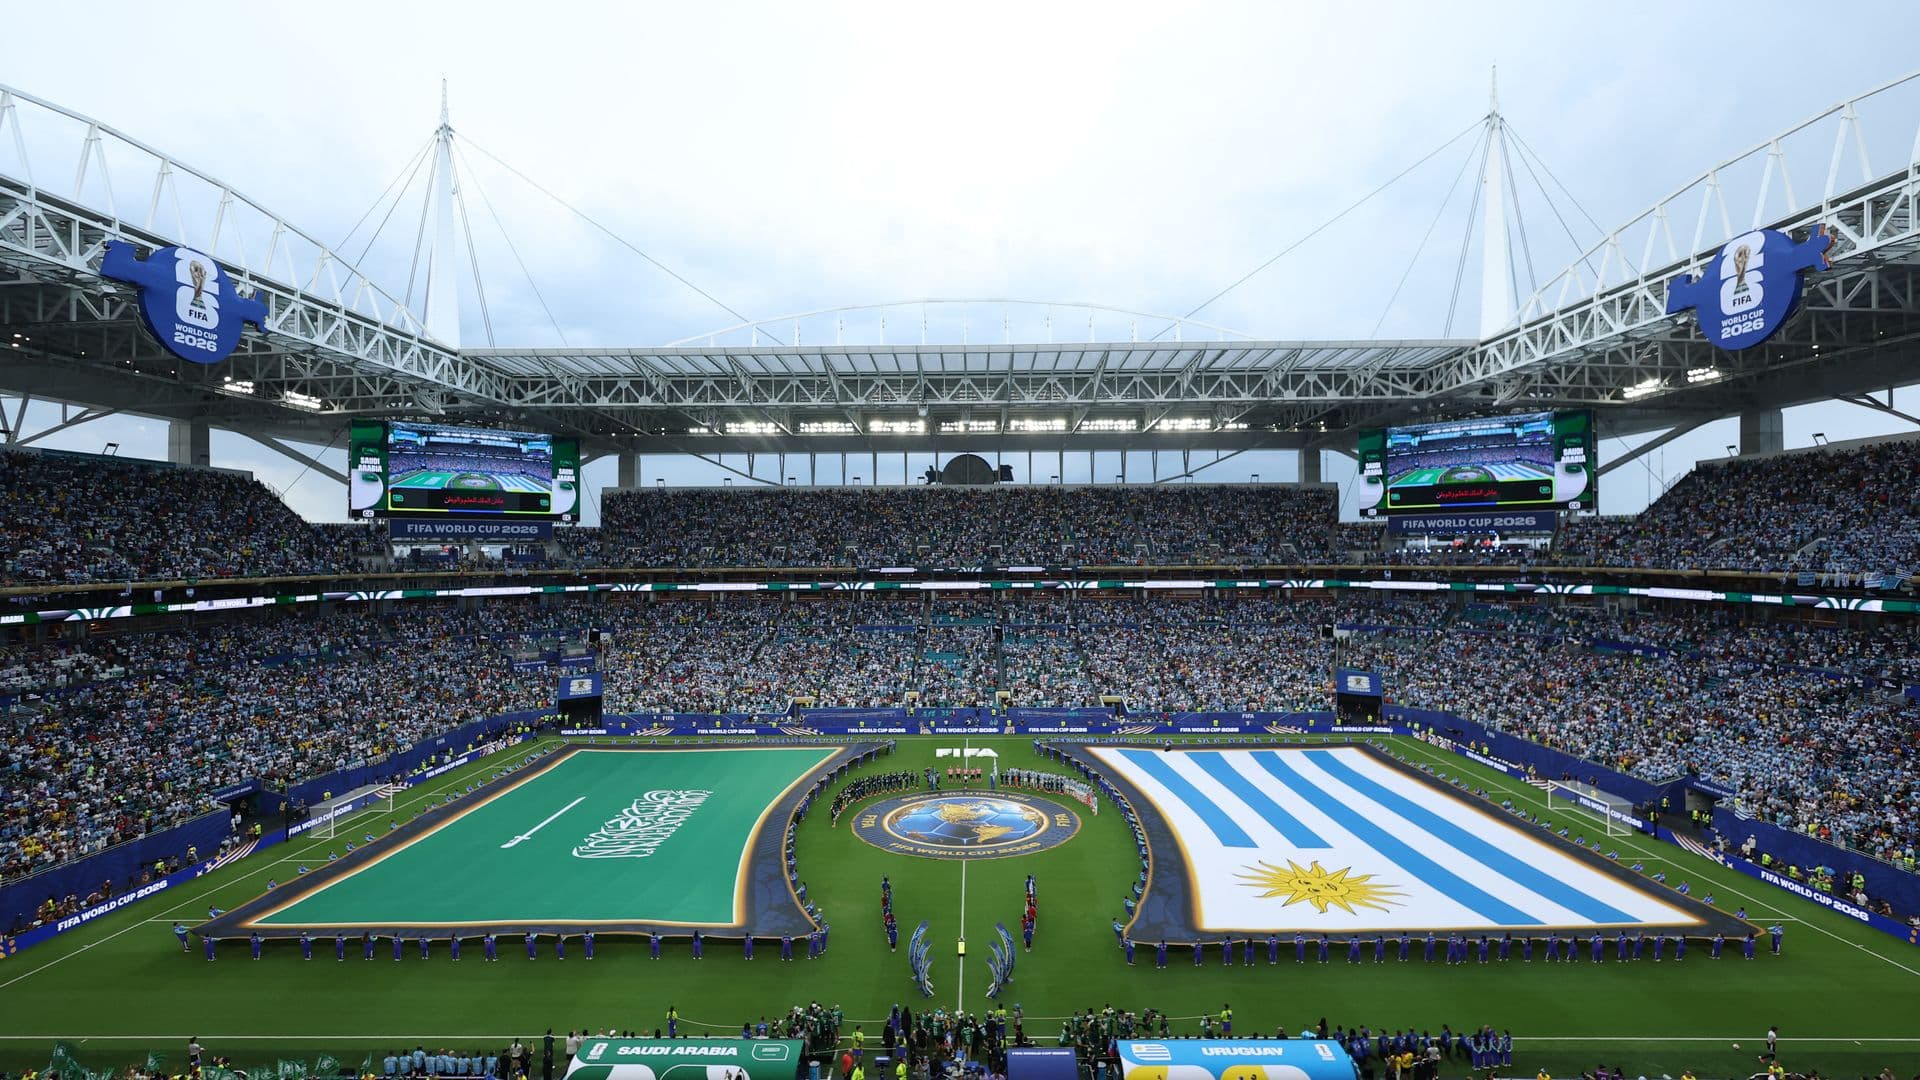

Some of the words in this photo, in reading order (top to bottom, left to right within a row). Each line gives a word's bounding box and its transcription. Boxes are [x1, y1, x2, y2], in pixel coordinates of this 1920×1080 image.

[1733, 295, 1752, 307] FIFA
[189, 309, 208, 322] FIFA
[1721, 314, 1748, 327] WORLD
[1749, 309, 1764, 320] CUP
[175, 323, 203, 337] WORLD
[203, 331, 218, 341] CUP
[1721, 318, 1765, 340] 2026
[174, 331, 218, 352] 2026
[407, 524, 433, 533] FIFA
[434, 524, 476, 533] WORLD
[478, 525, 500, 533] CUP
[501, 526, 539, 534] 2026
[1402, 520, 1426, 529] FIFA
[1426, 518, 1467, 528] WORLD
[1468, 518, 1492, 527] CUP
[1493, 517, 1537, 527] 2026
[936, 748, 999, 758] FIFA
[288, 824, 302, 837] FIFA
[302, 816, 323, 830] WORLD
[334, 804, 353, 816] 2026
[1610, 810, 1622, 819] CUP
[1622, 814, 1643, 828] 2026
[890, 842, 914, 851] FIFA
[917, 847, 966, 857] WORLD
[999, 842, 1042, 854] 2026
[1761, 870, 1780, 886] FIFA
[1780, 878, 1812, 898] WORLD
[1813, 892, 1832, 906] CUP
[1832, 901, 1870, 922] 2026
[57, 916, 80, 932] FIFA
[81, 901, 118, 922] WORLD
[118, 892, 137, 906] CUP
[136, 880, 168, 899] 2026
[616, 1046, 670, 1056] SAUDI
[671, 1046, 738, 1056] ARABIA
[1201, 1047, 1284, 1056] URUGUAY
